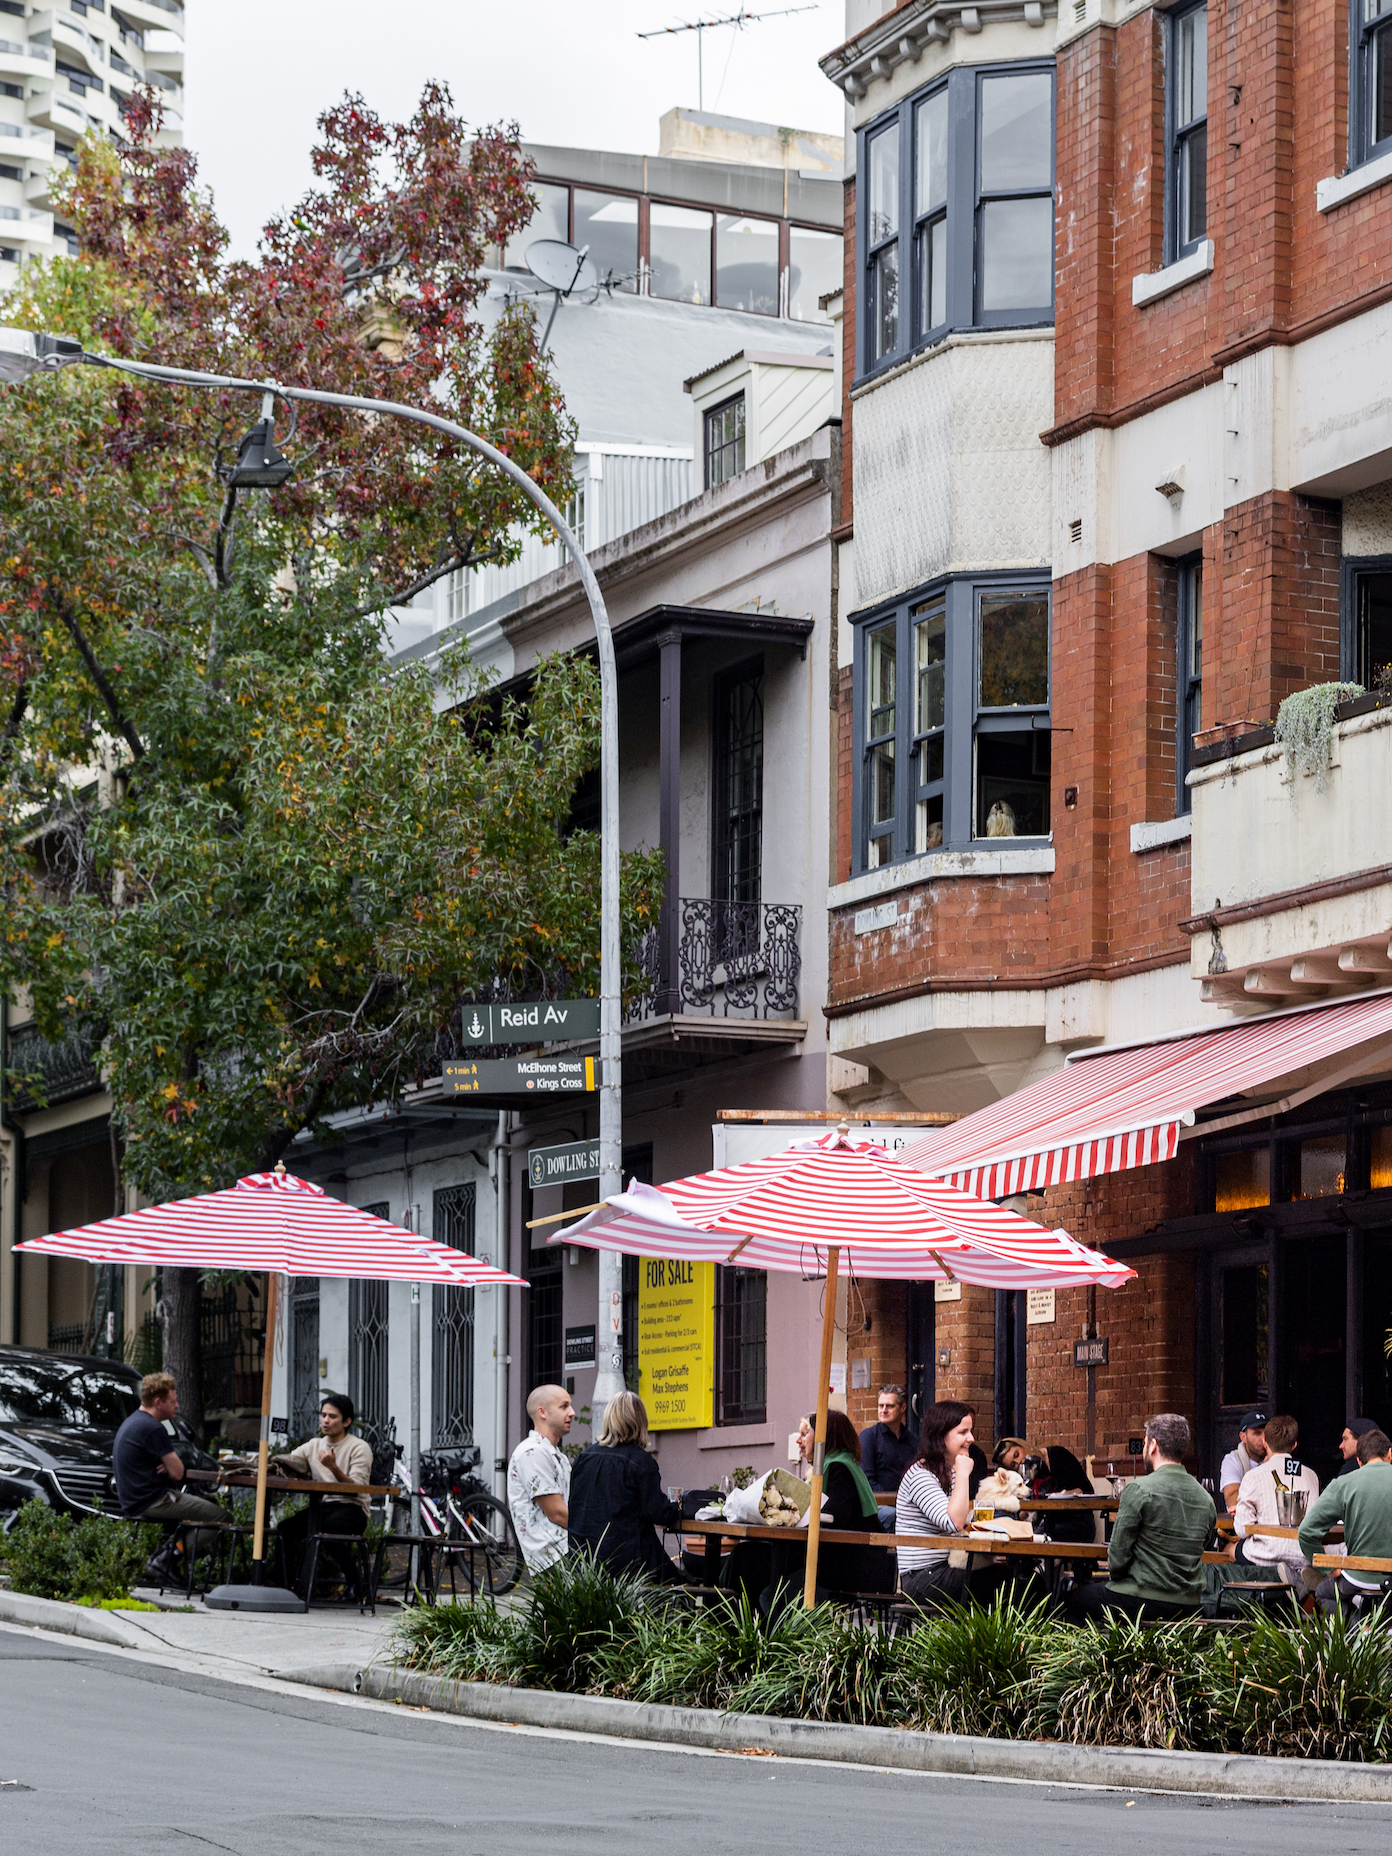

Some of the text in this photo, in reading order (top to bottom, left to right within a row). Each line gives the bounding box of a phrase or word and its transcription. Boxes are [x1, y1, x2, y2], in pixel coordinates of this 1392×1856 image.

[501, 1005, 568, 1027] Reid Av
[517, 1062, 582, 1073] McElhone Street
[454, 1082, 472, 1091] 5 min
[537, 1077, 583, 1091] Kings Cross
[547, 1149, 599, 1175] DOWLING ST
[646, 1260, 693, 1288] FOR SALE
[566, 1344, 594, 1354] PRACTICE
[1077, 1343, 1104, 1360] MAIN STAGE
[652, 1364, 689, 1380] Logan Grisaffe
[652, 1381, 689, 1395] Max Stephens
[655, 1399, 686, 1413] 9969 1500
[273, 1420, 286, 1431] 98
[1130, 1440, 1141, 1453] 83
[1286, 1459, 1300, 1474] 97
